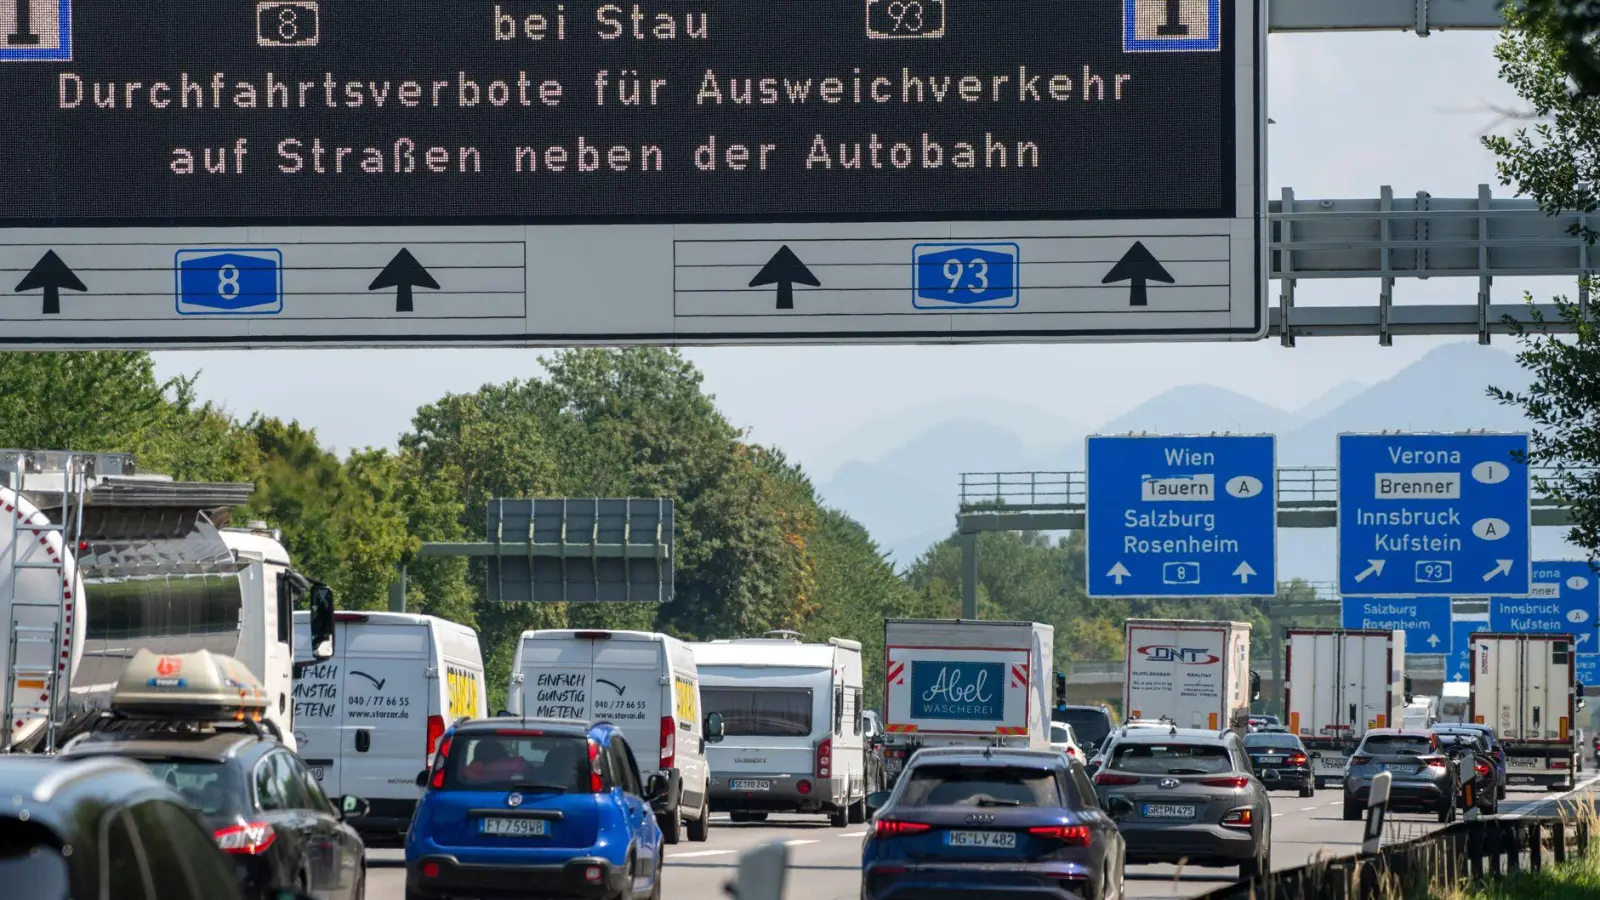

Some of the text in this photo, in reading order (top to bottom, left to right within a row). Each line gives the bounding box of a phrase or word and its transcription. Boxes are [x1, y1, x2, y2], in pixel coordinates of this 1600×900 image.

[495, 4, 707, 40] bei Stau
[887, 1, 926, 32] 93
[277, 9, 299, 39] 8
[60, 65, 1131, 108] Durchfahrtsverbote für Ausweichverkehr
[170, 133, 1038, 174] auf Straßen neben der Autobahn
[218, 264, 239, 299] 8
[943, 258, 989, 294] 93
[1165, 448, 1214, 466] Wien
[1388, 447, 1461, 464] Verona
[1149, 480, 1208, 495] Tauern
[1239, 481, 1249, 494] A
[1380, 479, 1453, 494] Brenner
[1124, 510, 1215, 531] Salzburg
[1357, 508, 1461, 525] Innsbruck
[1485, 523, 1497, 536] A
[1124, 535, 1238, 553] Rosenheim
[1375, 533, 1461, 551] Kufstein
[1177, 567, 1186, 579] 8
[1425, 565, 1442, 578] 93
[1532, 570, 1560, 578] rona
[1364, 603, 1417, 617] Salzburg
[1500, 603, 1560, 614] Innsbruck
[1363, 619, 1431, 630] Rosenheim
[1511, 619, 1561, 630] Kufstein
[302, 664, 338, 680] FACH
[922, 666, 993, 702] Abel
[348, 695, 410, 707] 040 / 77 66 55
[594, 700, 609, 709] 040
[616, 700, 625, 709] 77
[626, 700, 636, 709] 66
[637, 700, 646, 710] 55
[348, 709, 409, 719] www.starcar.de
[594, 711, 646, 720] www.starcar.de
[923, 703, 993, 715] WÄSCHEREI
[1148, 805, 1194, 816] GR PN 475
[486, 819, 543, 833] FY 759WB
[950, 832, 1015, 846] HG LY 482
